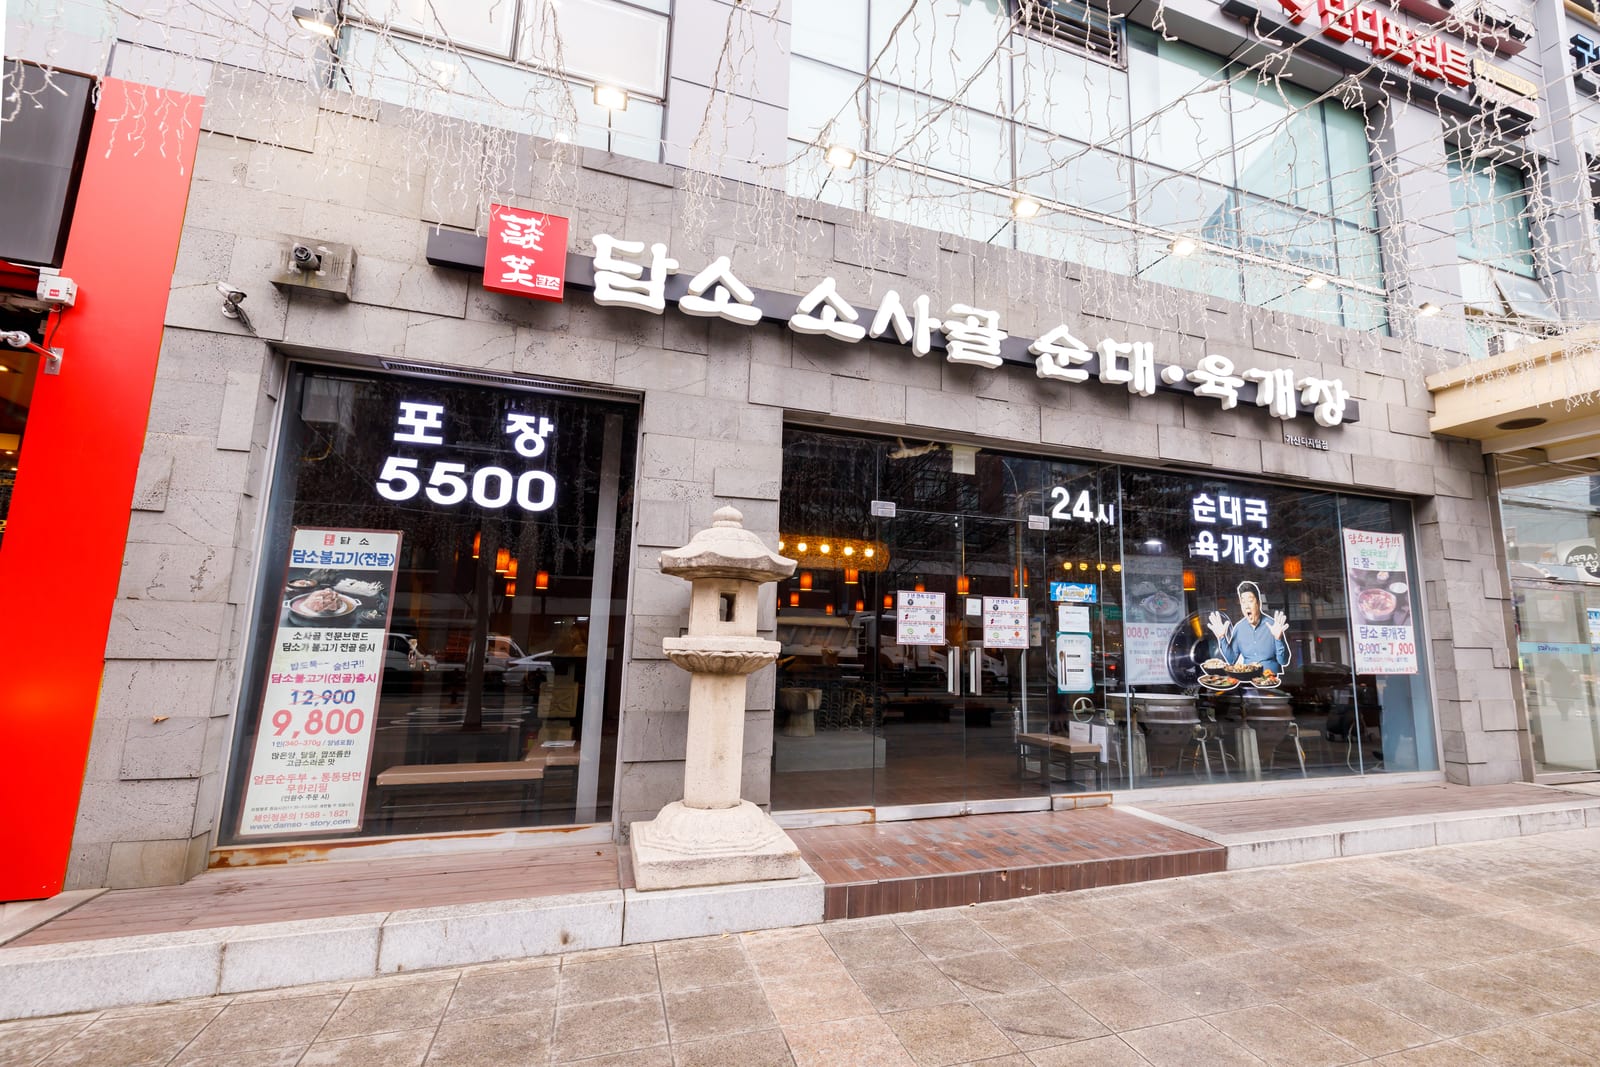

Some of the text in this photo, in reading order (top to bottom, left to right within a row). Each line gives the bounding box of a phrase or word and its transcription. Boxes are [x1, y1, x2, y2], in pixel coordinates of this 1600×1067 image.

[592, 233, 763, 326] 담소
[788, 276, 1008, 369] 소사골
[375, 456, 557, 512] 5500
[1050, 486, 1114, 526] 24시
[1191, 493, 1269, 529] 순대국
[292, 549, 395, 567] 담소불고기(전골)
[1193, 531, 1272, 569] 육개장
[292, 632, 369, 641] 소사골 전문브랜드
[1359, 626, 1407, 640] 담소 육개장
[282, 642, 376, 652] 담소가 불고기 전골 출시
[1388, 643, 1415, 656] 7,900
[290, 689, 356, 706] 12,900
[272, 708, 365, 739] 9,800
[327, 758, 336, 766] 맛
[287, 783, 328, 793] 무한리필
